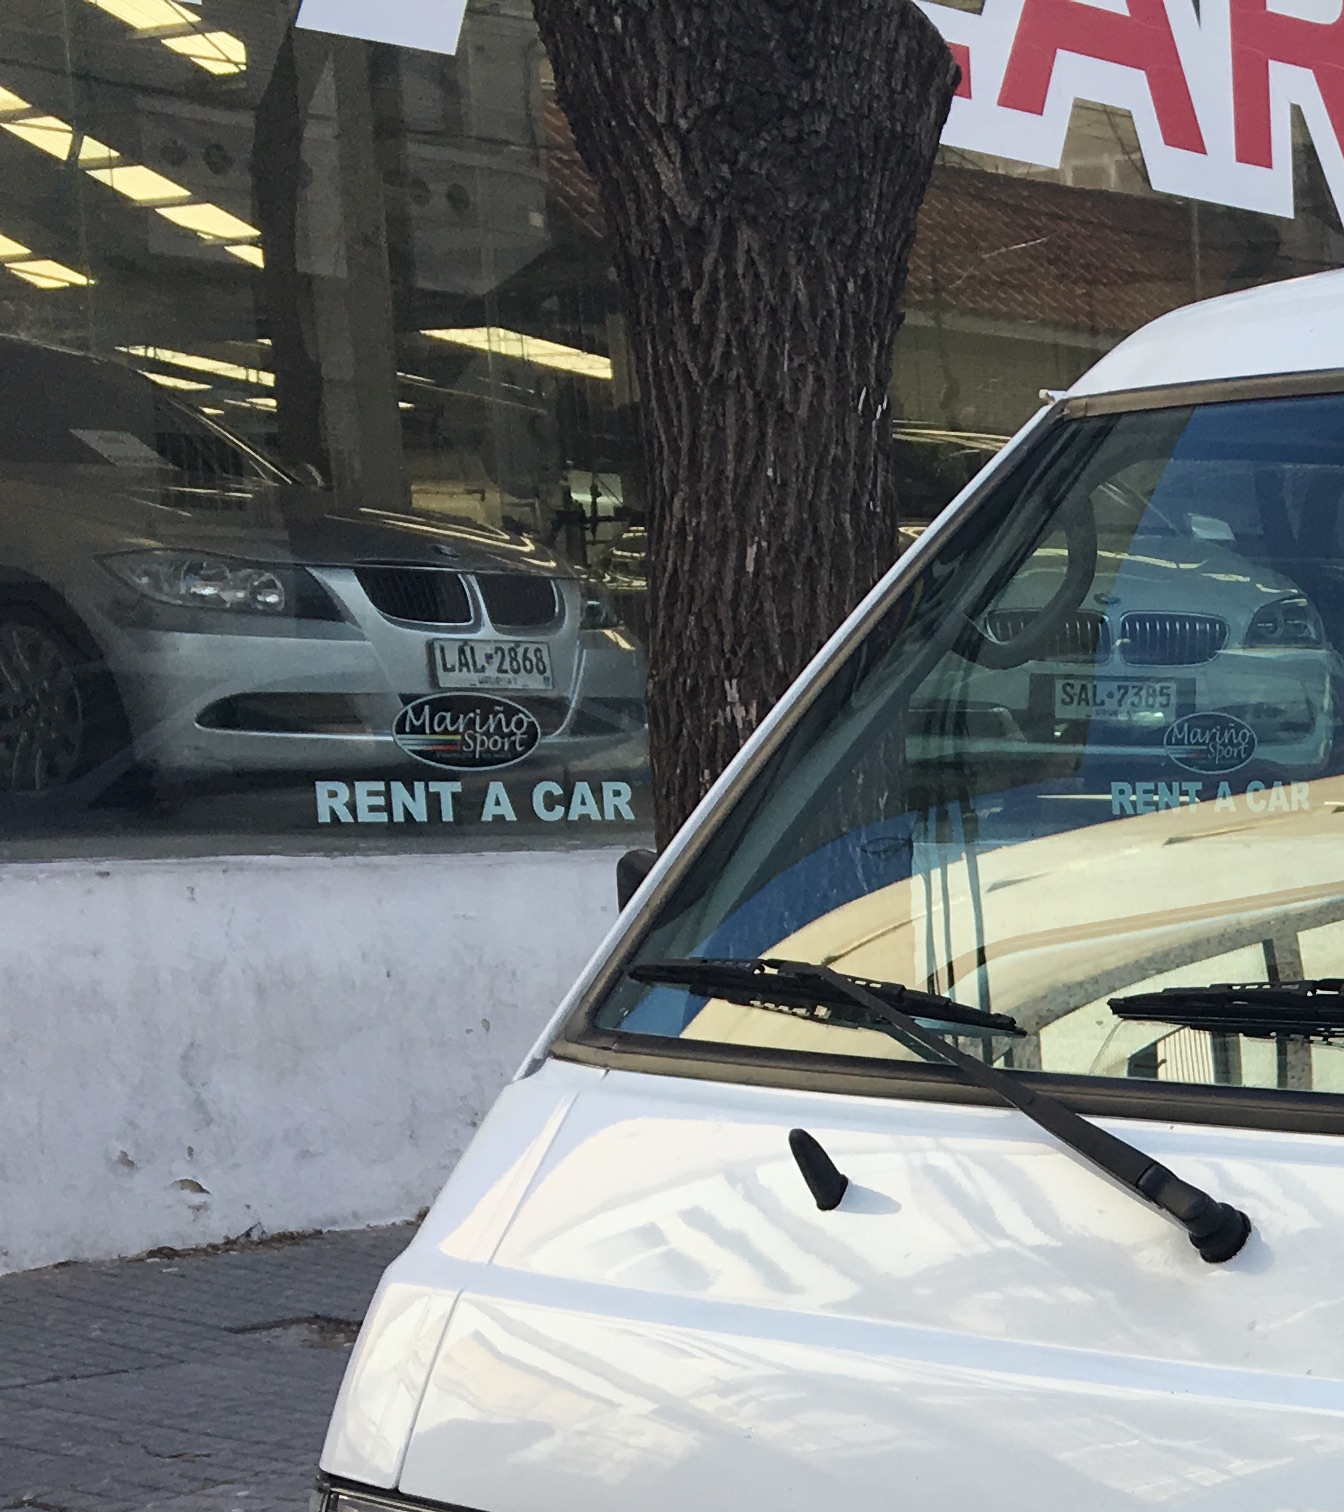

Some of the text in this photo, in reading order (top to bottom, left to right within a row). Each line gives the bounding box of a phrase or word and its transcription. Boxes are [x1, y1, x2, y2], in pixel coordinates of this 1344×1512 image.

[404, 704, 533, 735] Mariño
[1171, 722, 1251, 745] Mariño
[462, 729, 528, 759] Sport
[1207, 741, 1249, 765] Sport
[314, 780, 635, 823] RENT A CAR
[1110, 780, 1313, 815] RENT A CAR
